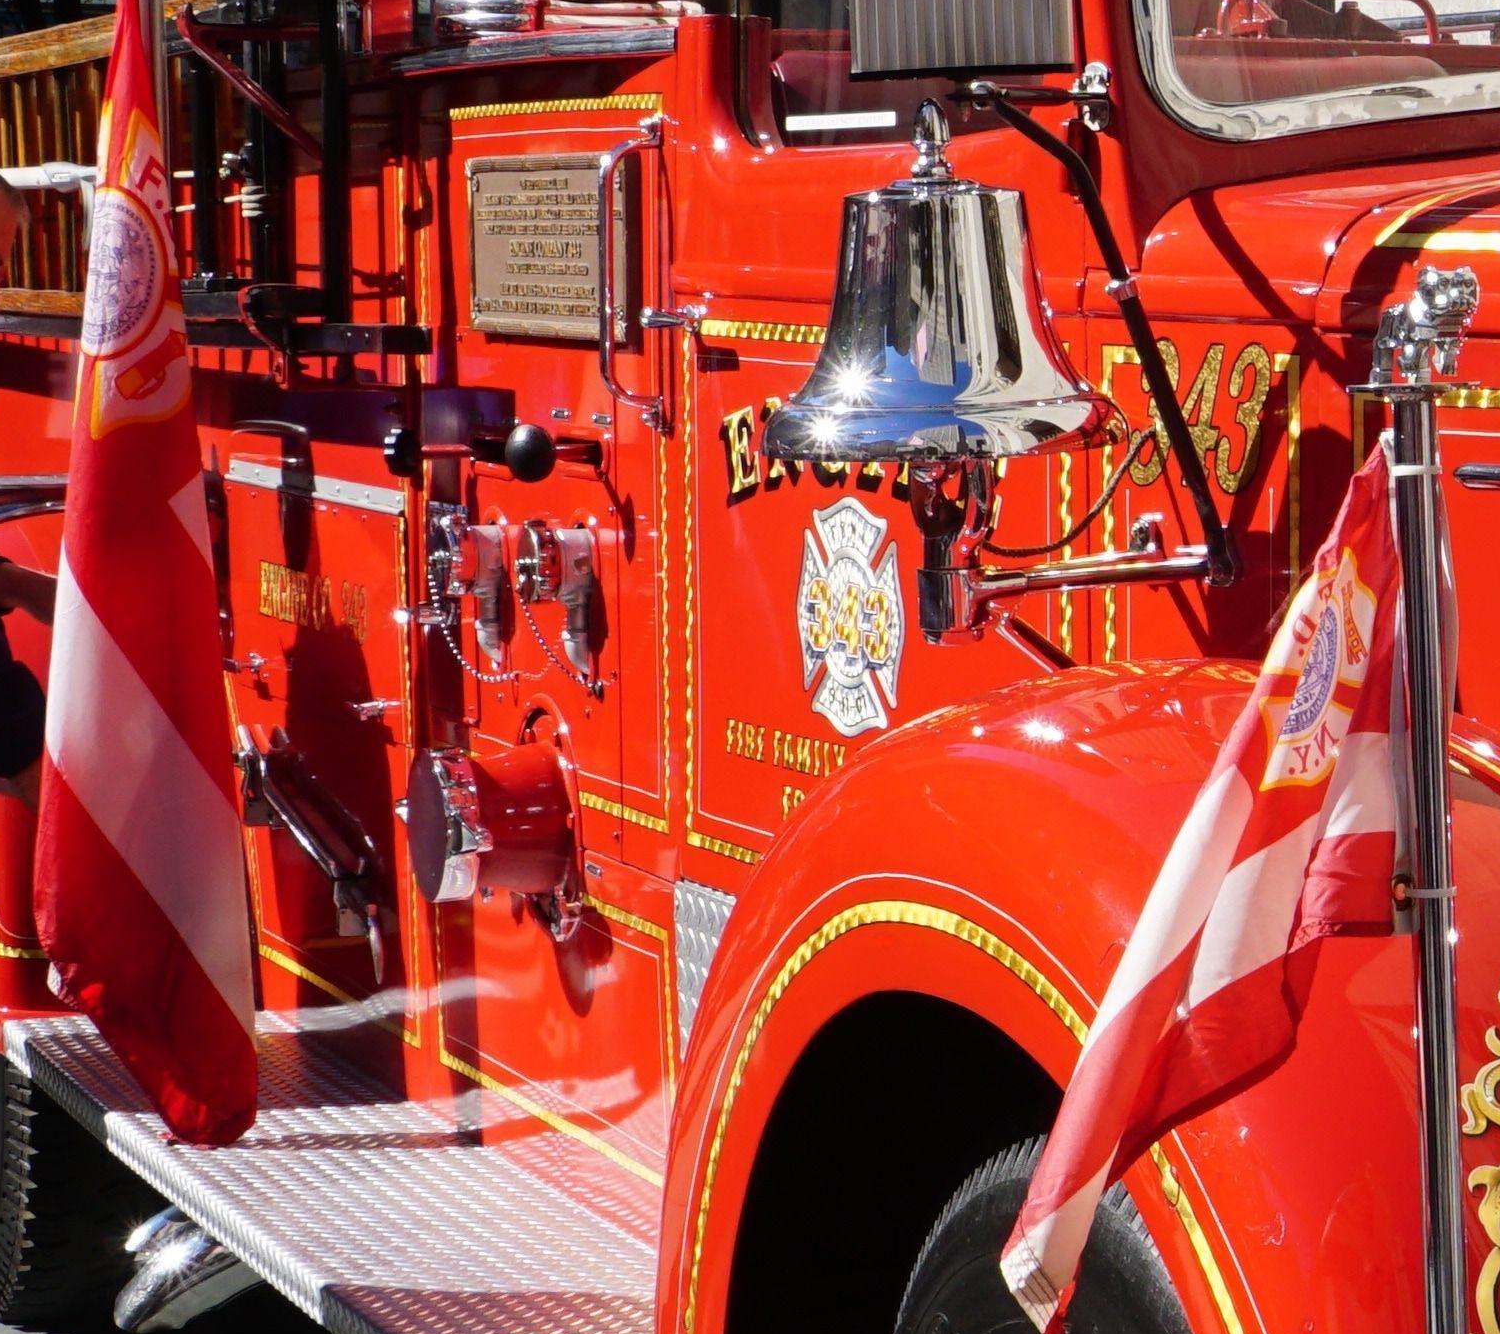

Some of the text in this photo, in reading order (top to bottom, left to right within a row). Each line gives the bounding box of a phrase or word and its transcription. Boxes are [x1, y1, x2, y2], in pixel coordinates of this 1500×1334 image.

[1129, 337, 1271, 494] 343
[807, 576, 893, 665] 343
[726, 718, 846, 778] FIRE FAMILY
